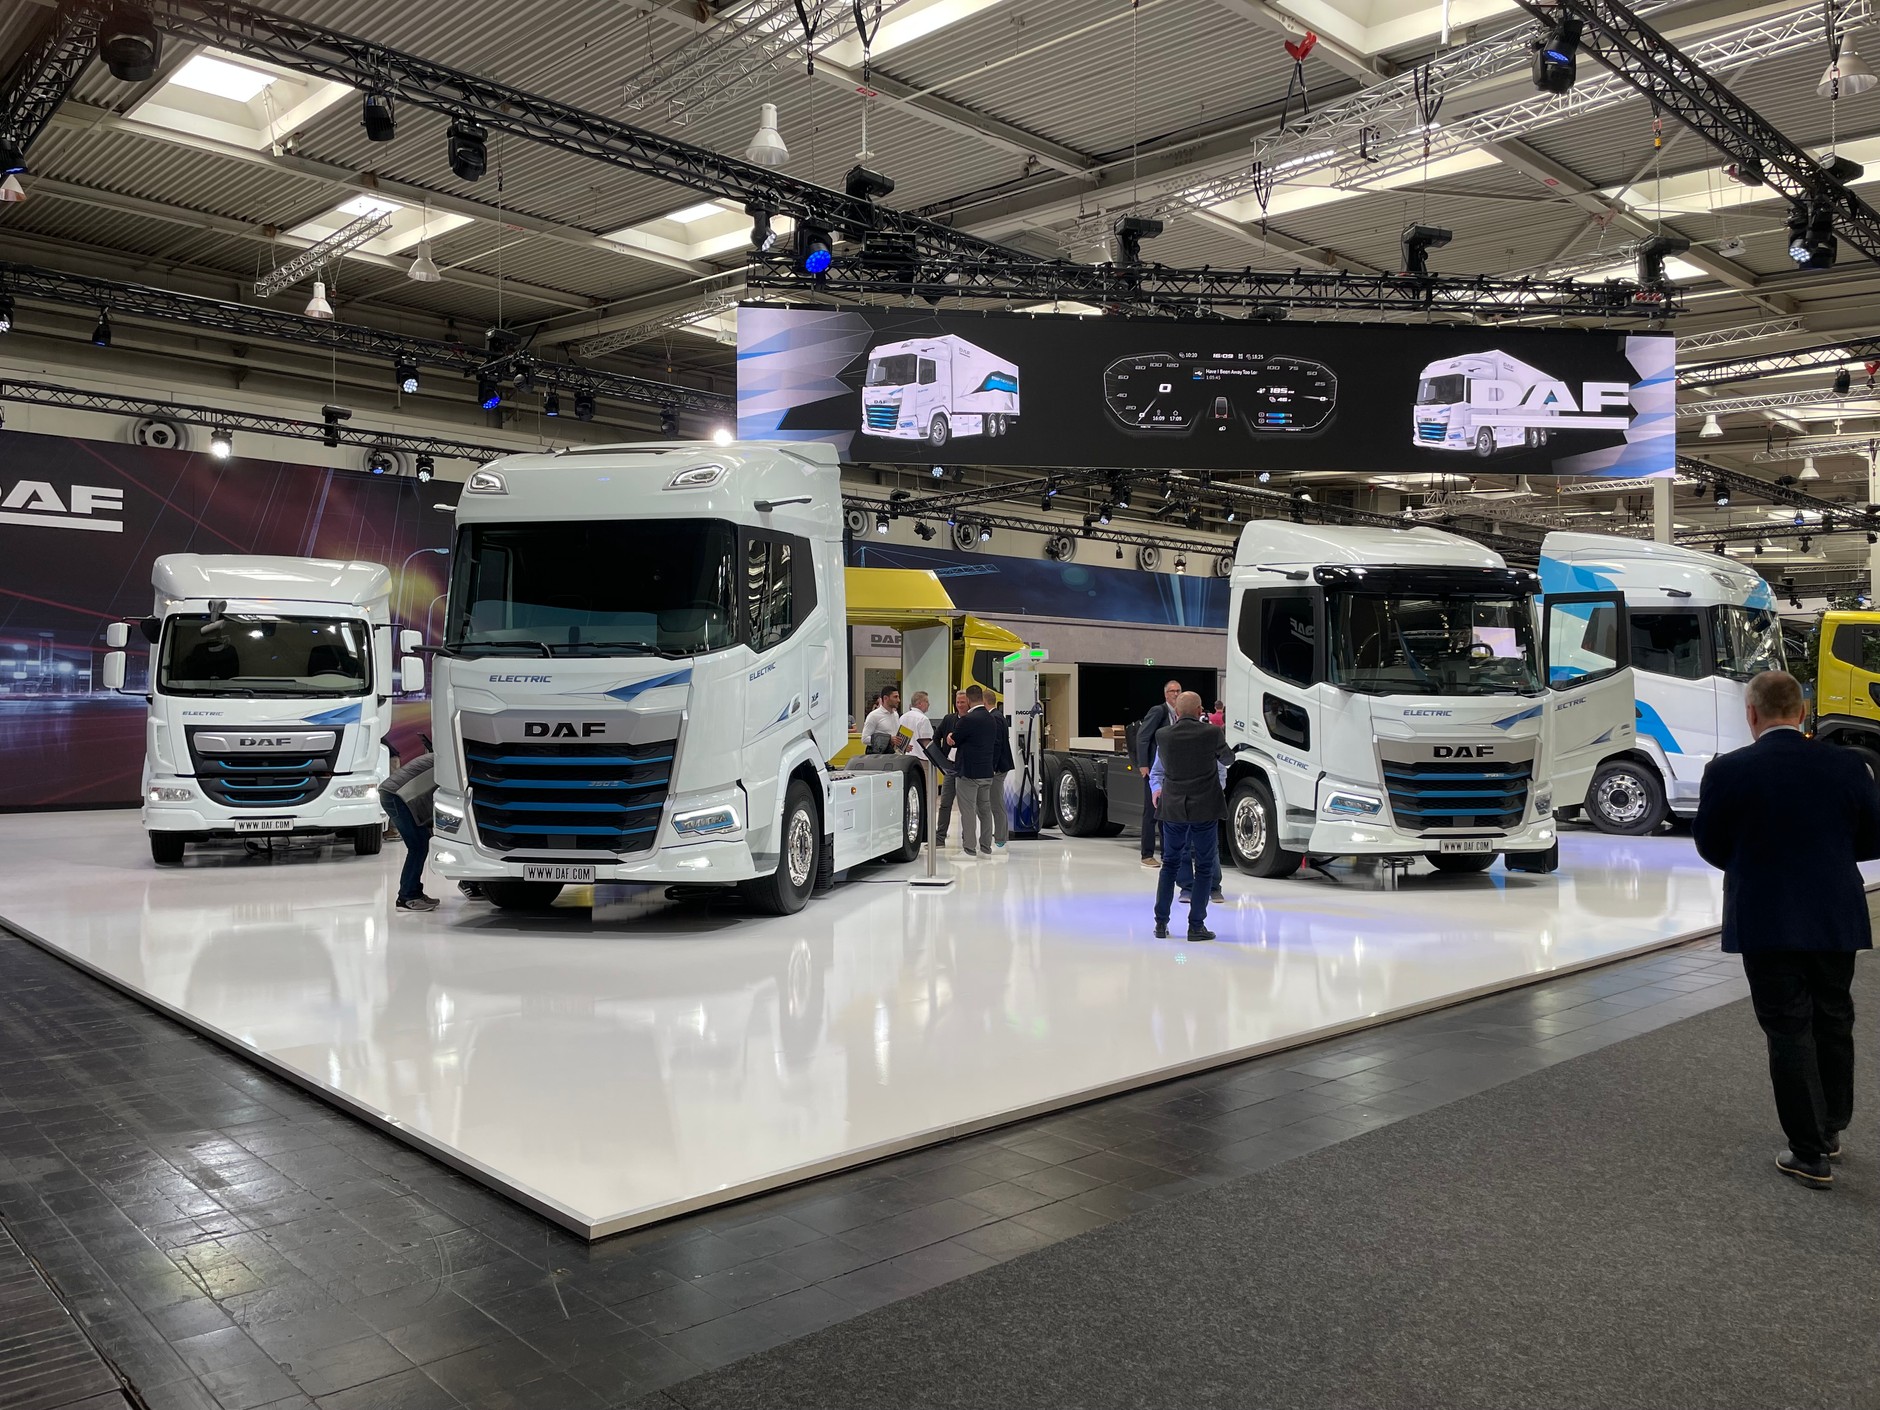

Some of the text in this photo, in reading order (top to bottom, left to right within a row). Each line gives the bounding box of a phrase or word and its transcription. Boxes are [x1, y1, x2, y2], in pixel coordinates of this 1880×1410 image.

[1471, 379, 1629, 412] DAF
[0, 480, 123, 514] AF
[489, 675, 552, 683] ELECTRIC
[749, 661, 776, 681] ELECTRIC
[1403, 709, 1453, 717] ELECTRIC
[524, 722, 606, 738] DAF
[239, 738, 292, 746] DAF
[1433, 746, 1494, 758] DAF
[1276, 753, 1309, 770] ELECTRIC
